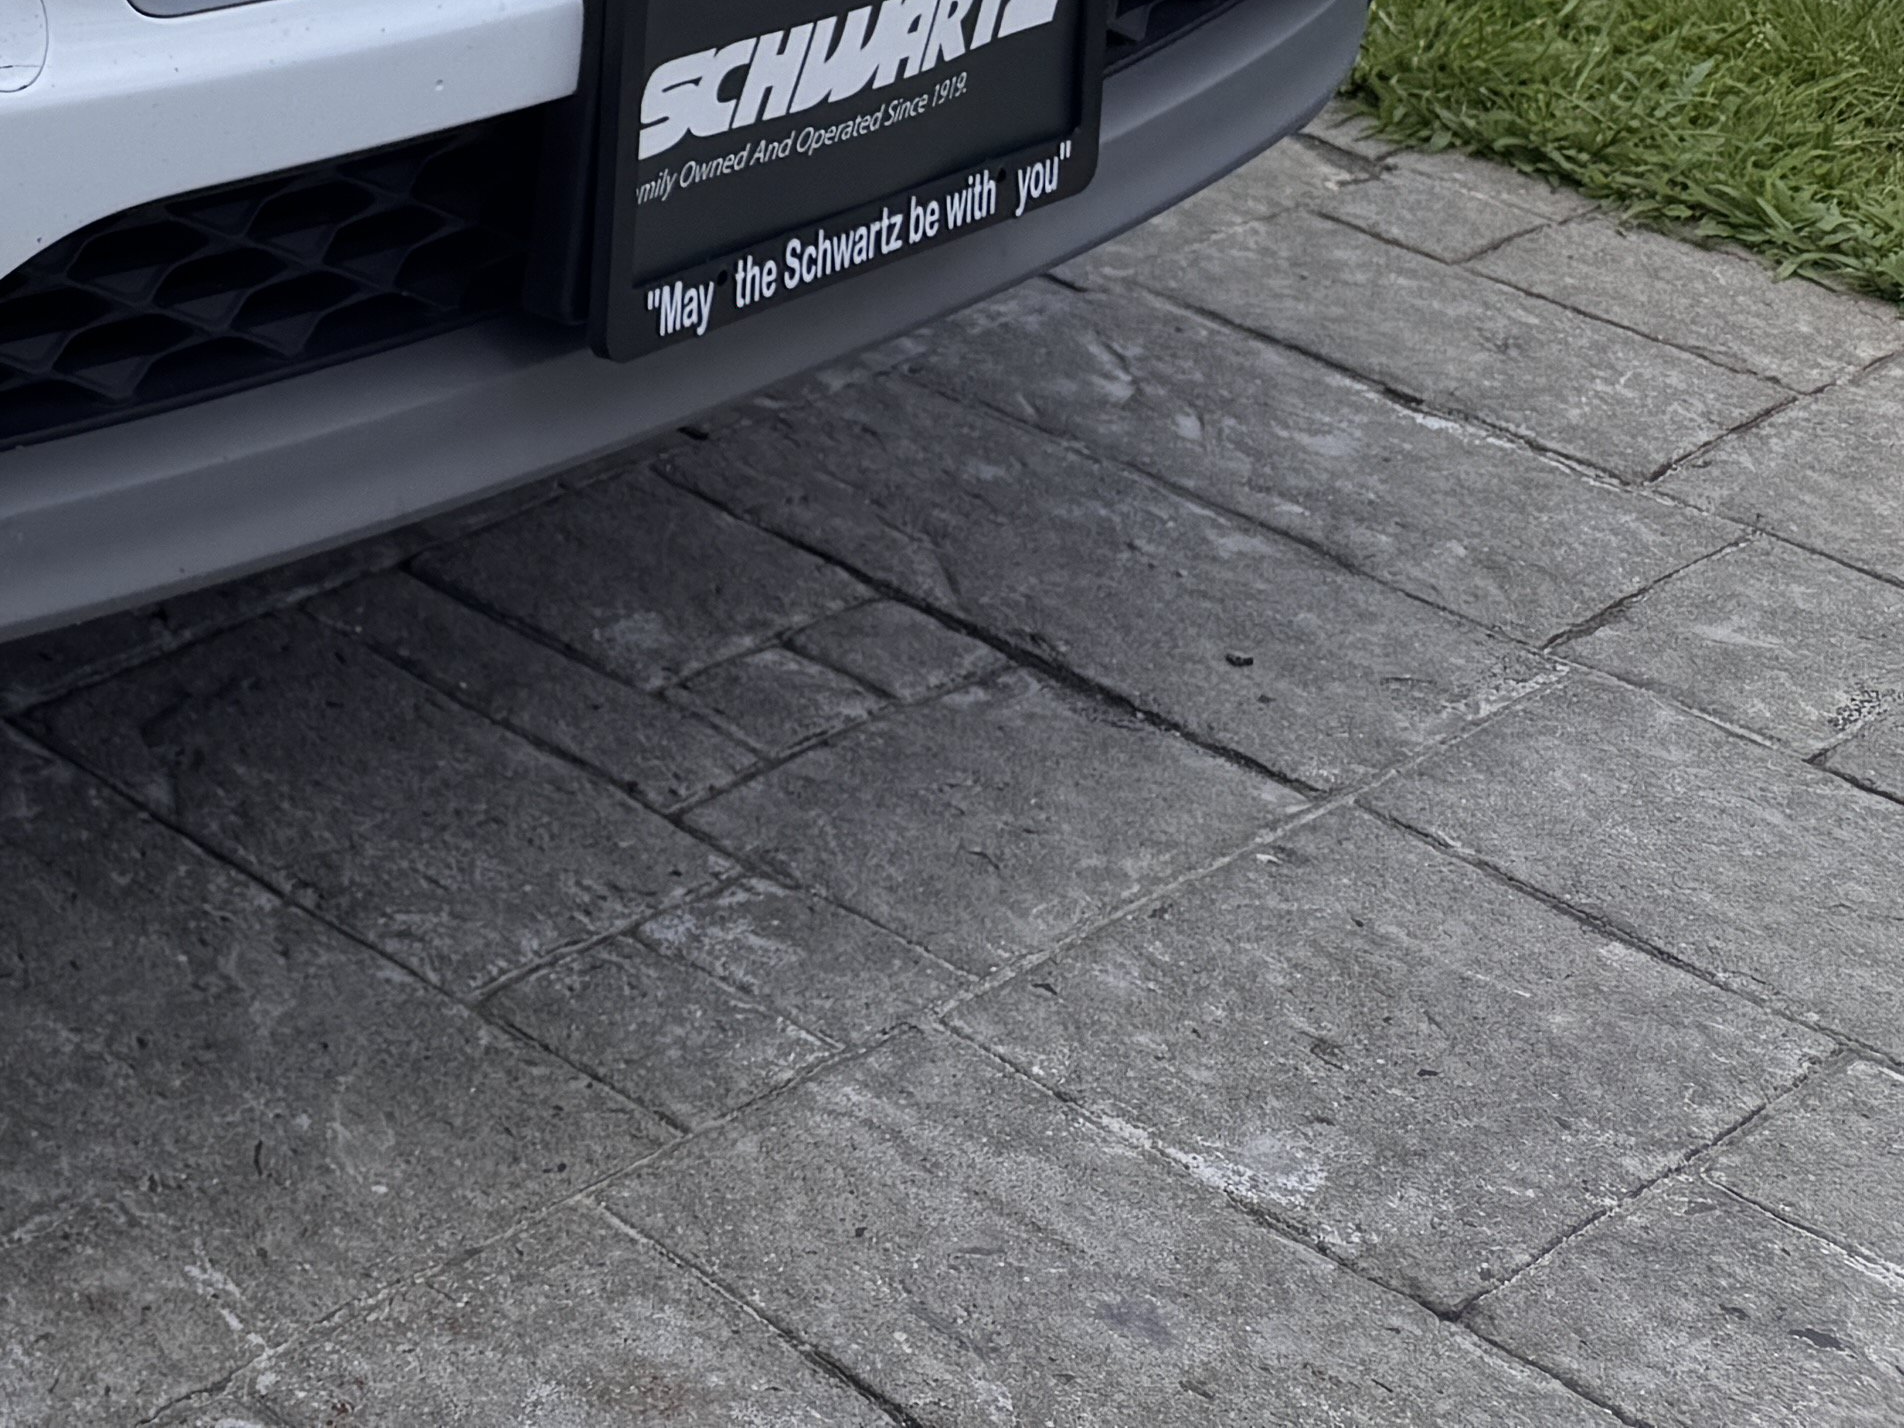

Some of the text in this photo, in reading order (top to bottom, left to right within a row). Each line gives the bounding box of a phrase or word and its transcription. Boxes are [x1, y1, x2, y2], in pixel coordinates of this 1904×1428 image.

[636, 168, 678, 206] mily
[679, 143, 751, 189] Owned
[749, 130, 795, 167] And
[796, 103, 886, 156] Operated
[884, 94, 928, 127] Since
[646, 141, 1072, 336] "May the Schwartz be with you"
